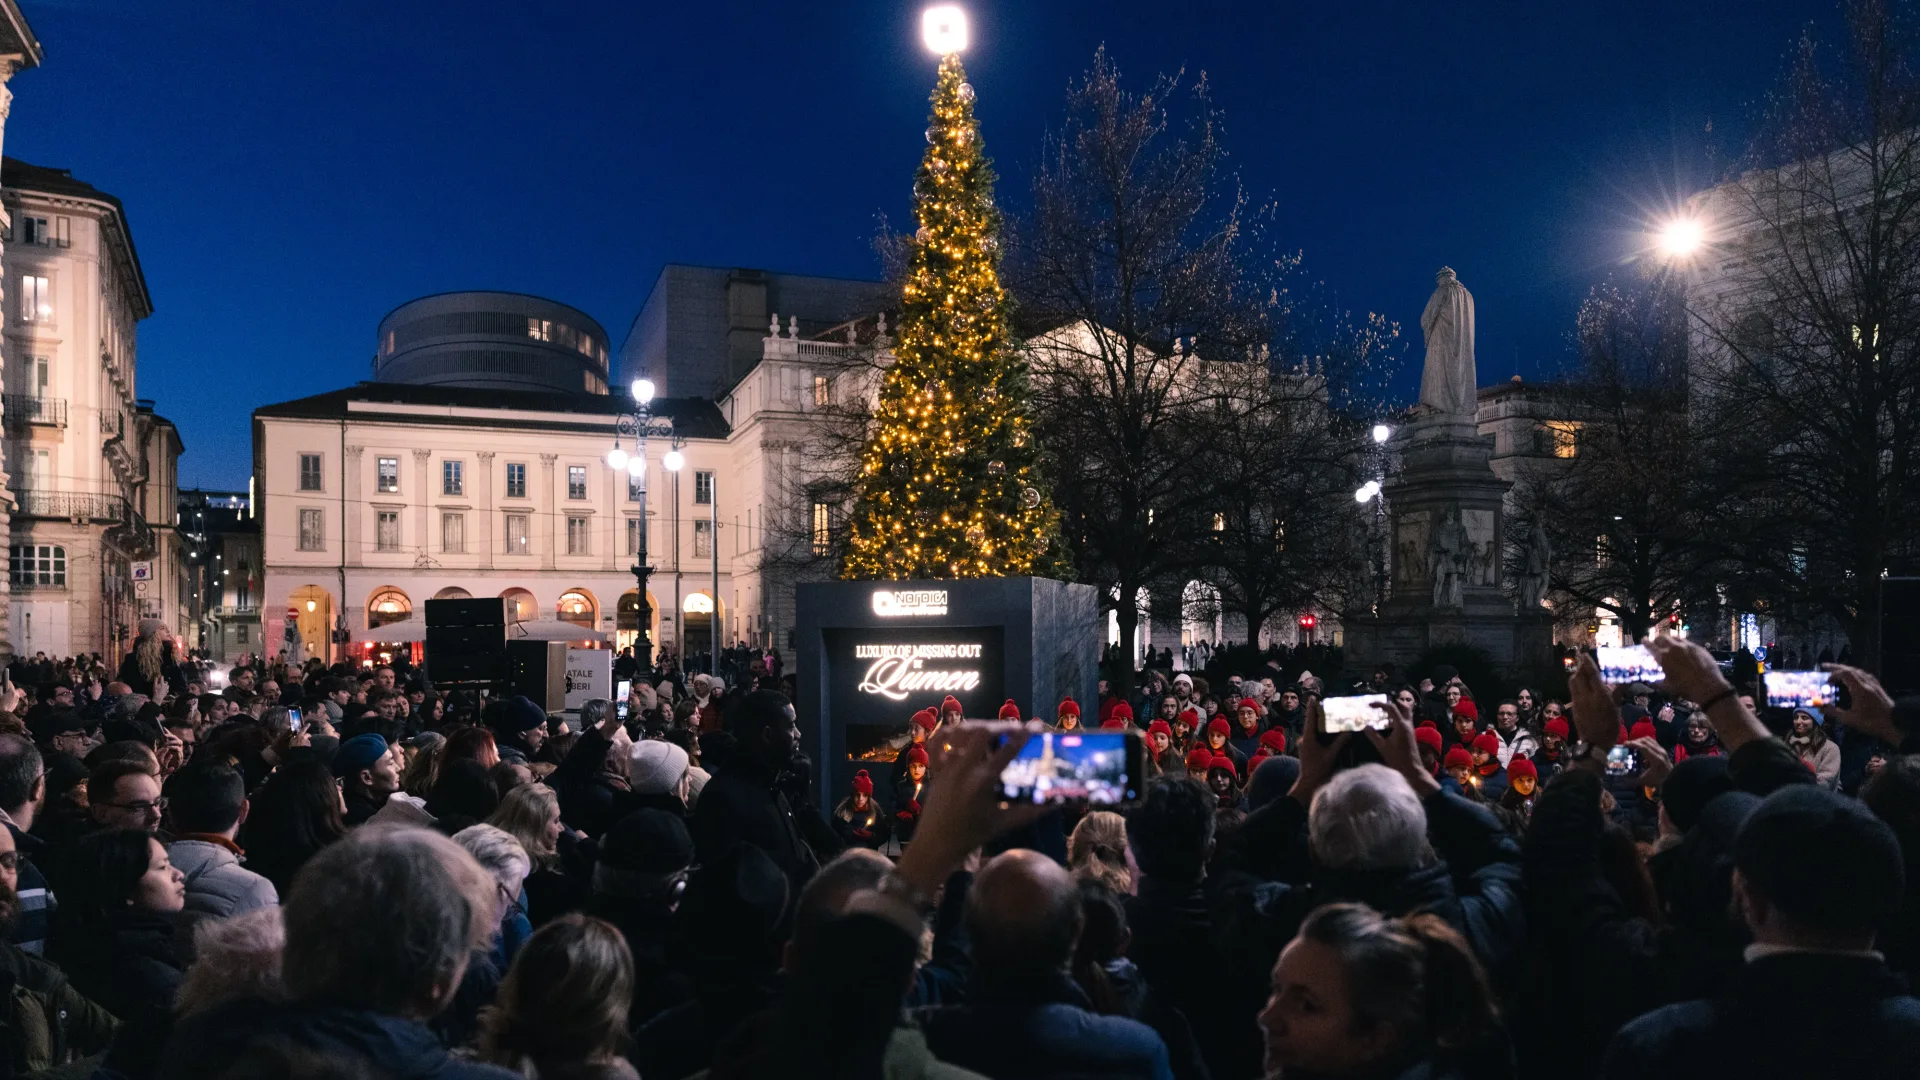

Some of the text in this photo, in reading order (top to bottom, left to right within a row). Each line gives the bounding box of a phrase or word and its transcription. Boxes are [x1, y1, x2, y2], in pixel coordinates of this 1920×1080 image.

[856, 645, 981, 658] LUXURY OF MISSING OUT
[566, 669, 593, 678] ATALE
[858, 656, 980, 700] Lumen
[571, 682, 591, 690] BERI
